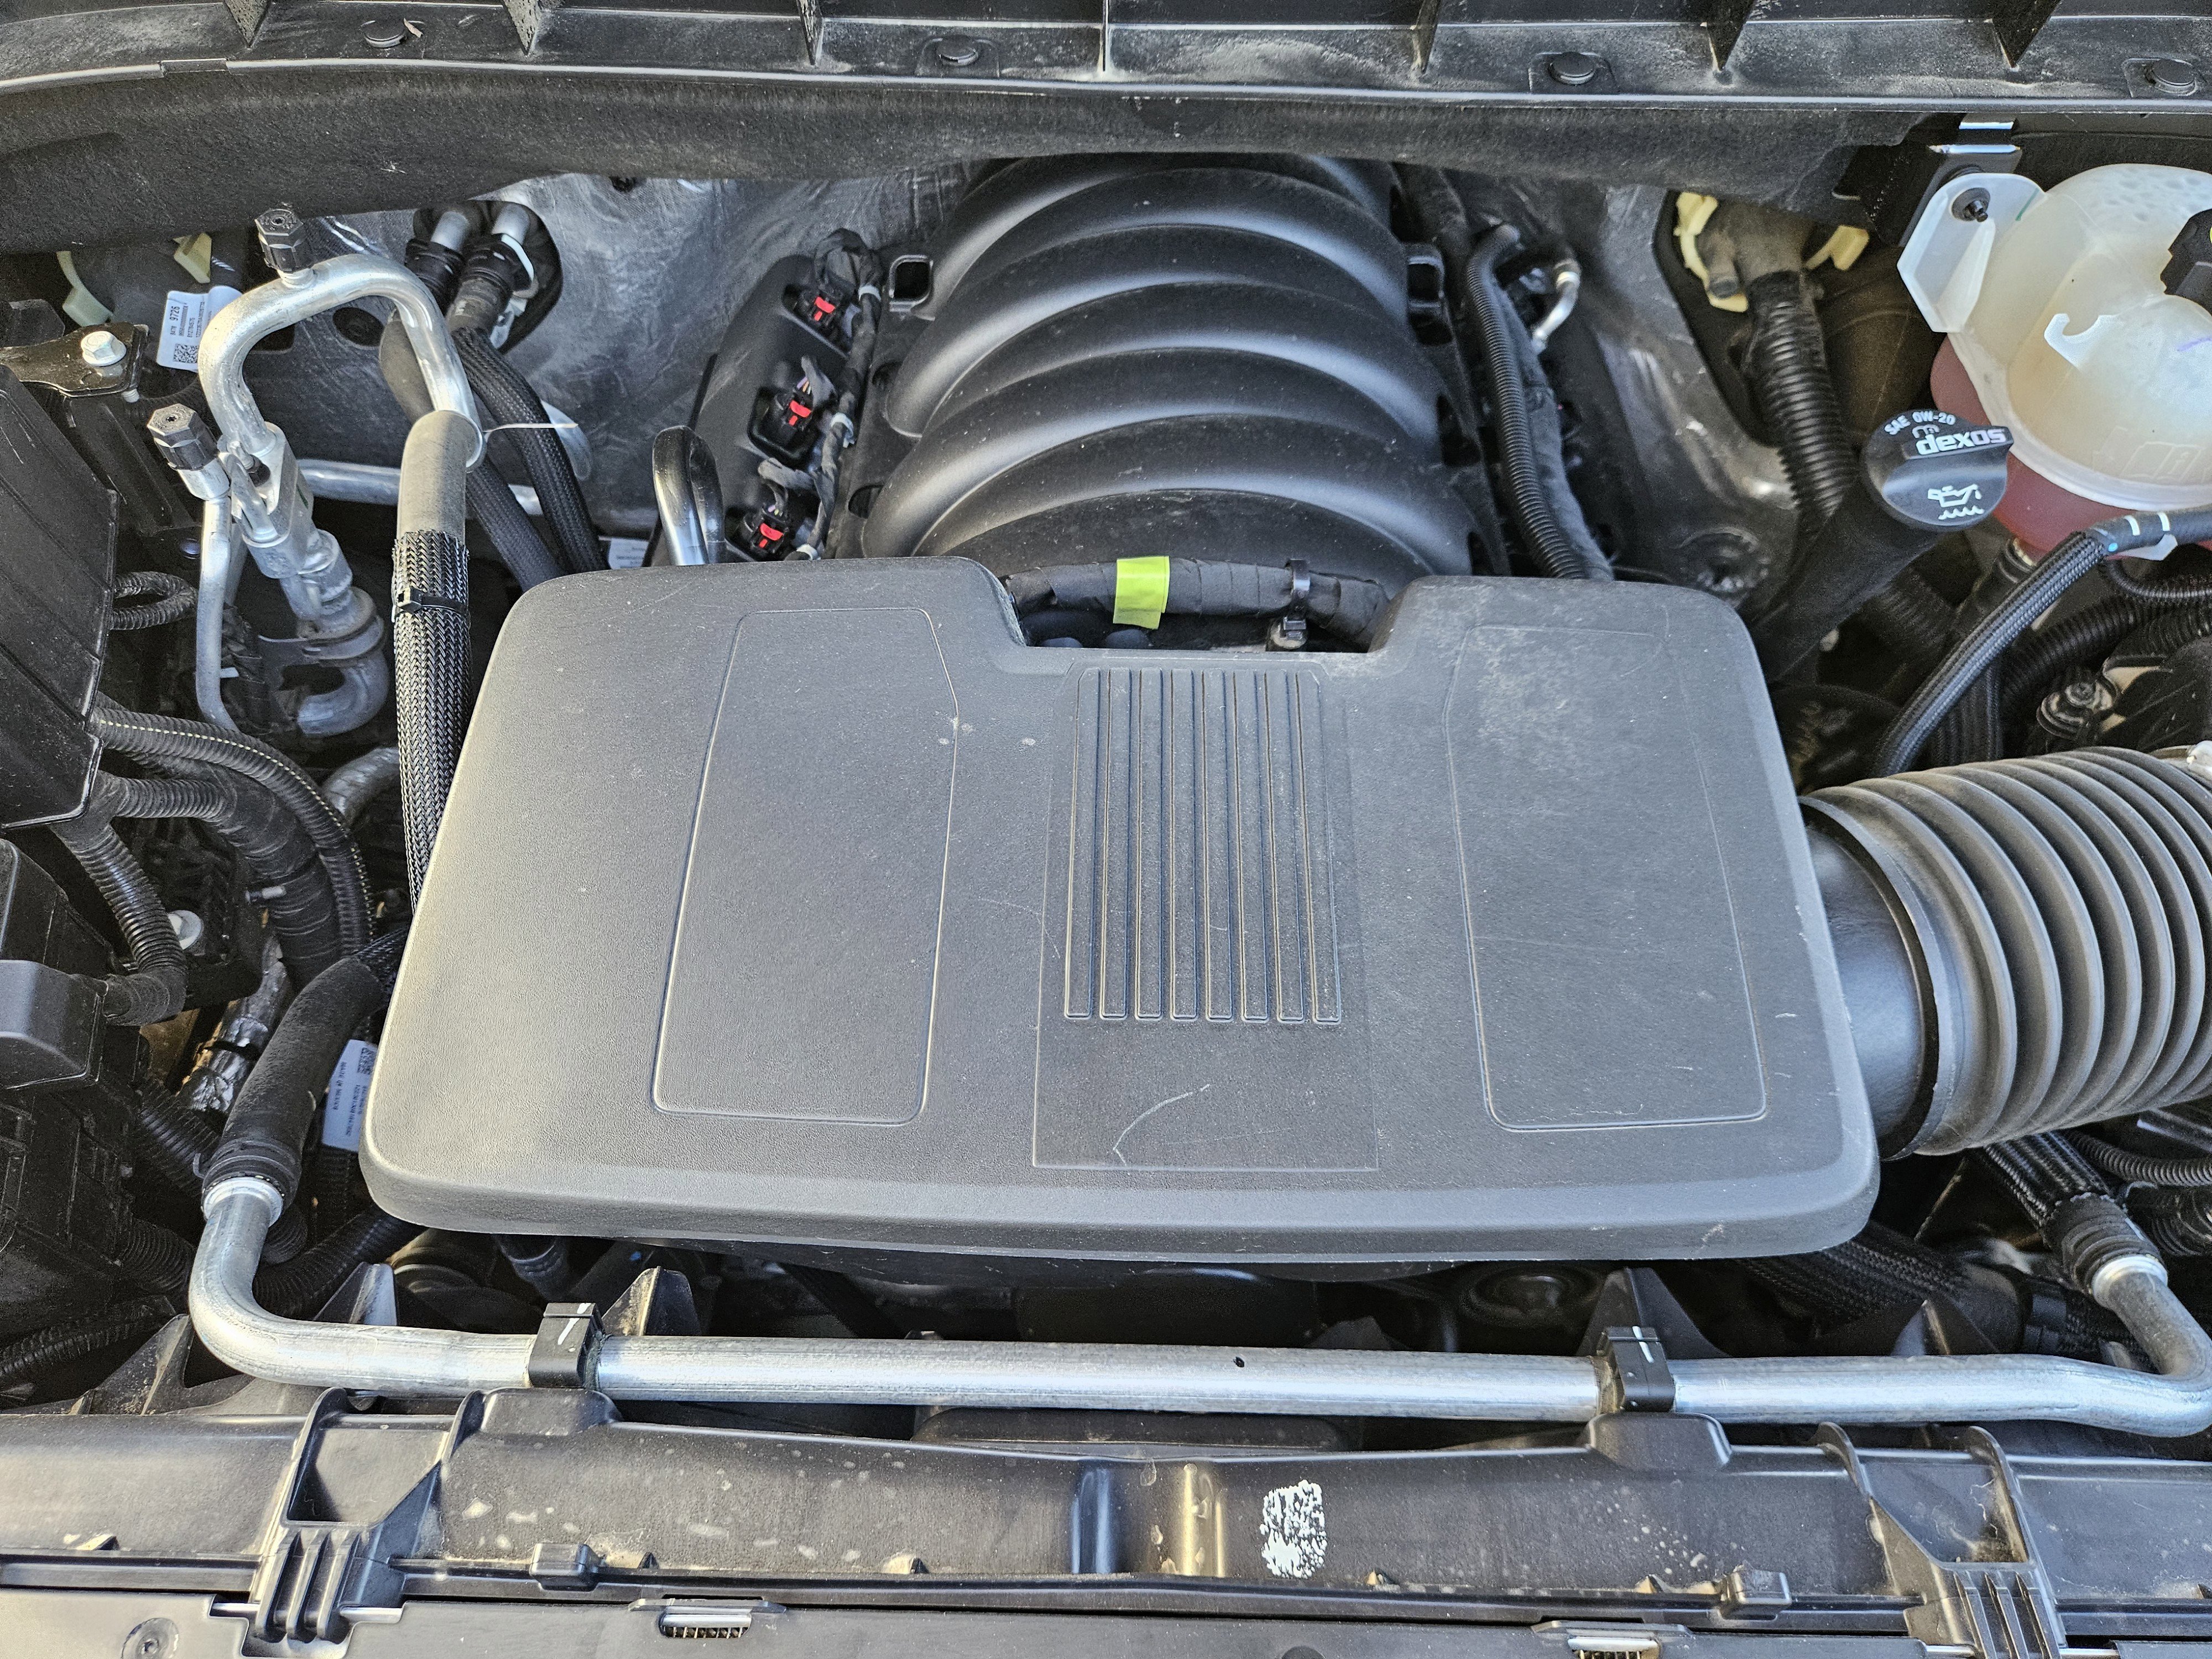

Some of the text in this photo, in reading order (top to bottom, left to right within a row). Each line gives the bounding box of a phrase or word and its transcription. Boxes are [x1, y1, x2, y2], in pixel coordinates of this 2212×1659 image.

[170, 306, 180, 321] 9726
[1884, 410, 1957, 435] SAE 0W-20
[1916, 429, 2007, 455] dexos
